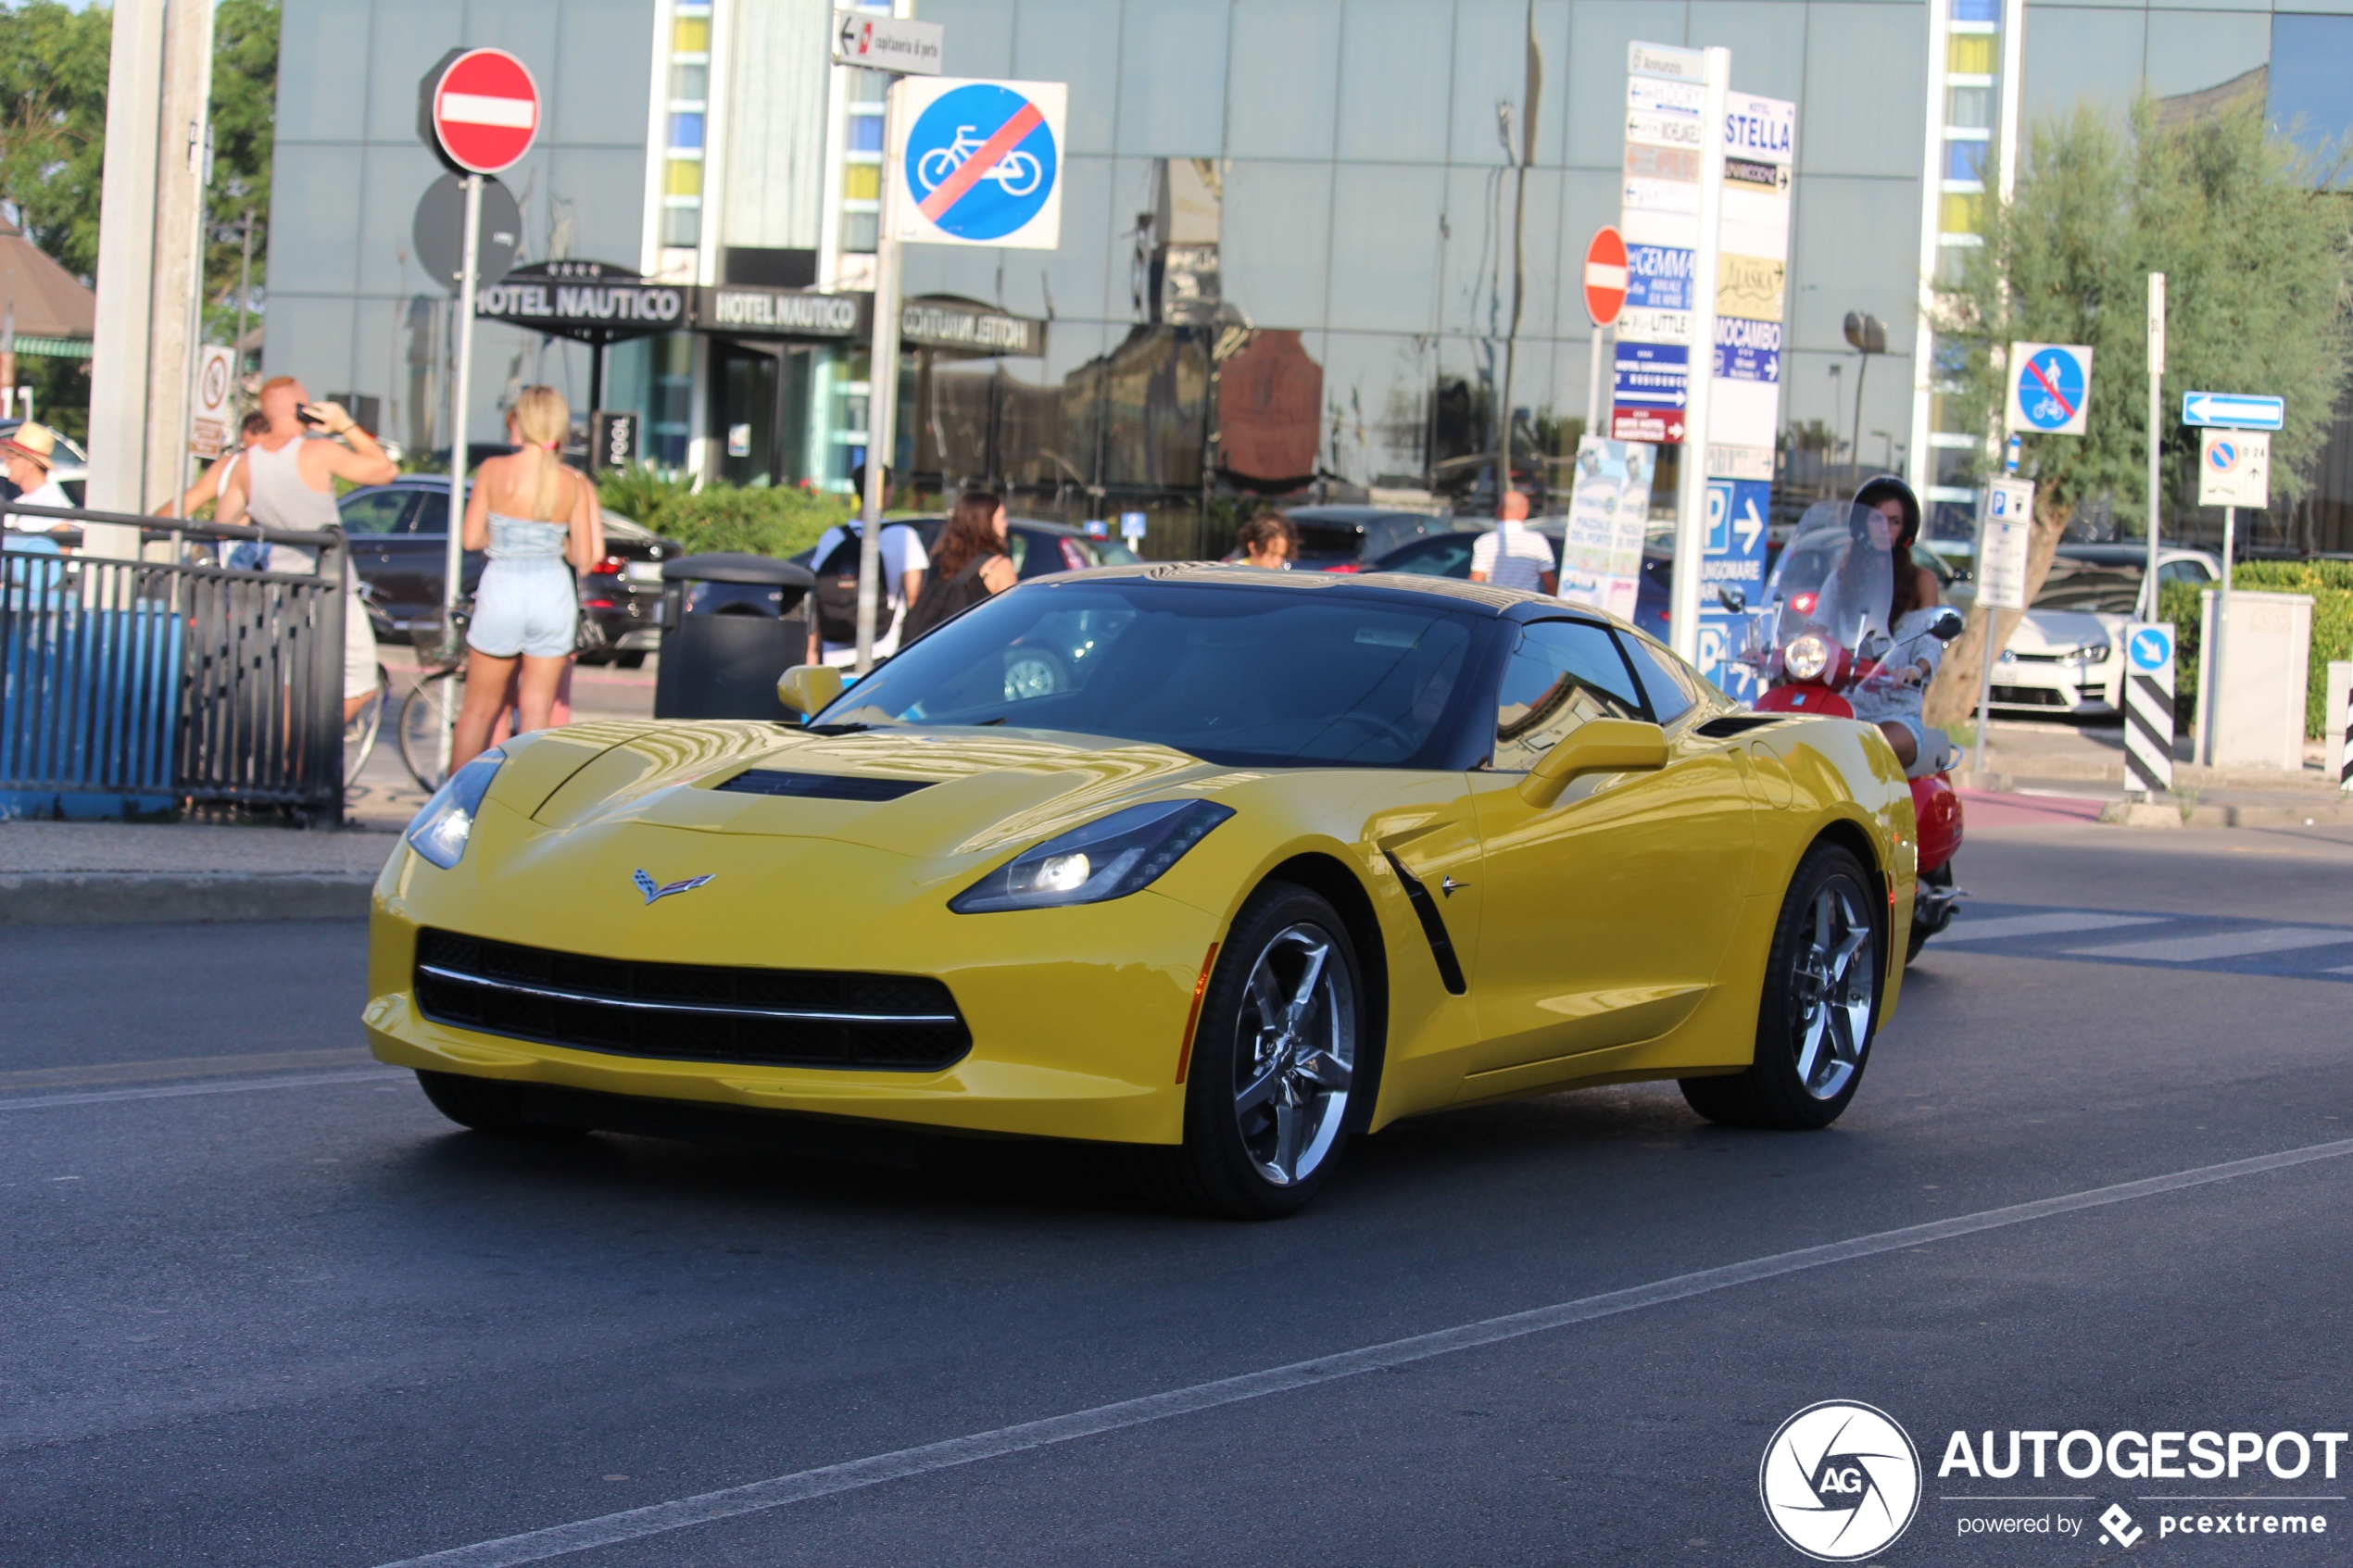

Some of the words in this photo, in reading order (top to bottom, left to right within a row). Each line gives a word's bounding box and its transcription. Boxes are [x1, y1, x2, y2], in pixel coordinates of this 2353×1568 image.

[1725, 113, 1790, 153] STELLA
[1637, 247, 1695, 279] GEMMA
[555, 284, 682, 321] NAUTICO
[715, 292, 774, 325] HOTEL
[776, 295, 857, 331] NAUTICO
[1652, 314, 1686, 333] LITTLE
[1714, 317, 1780, 352] MOCAMBO
[610, 416, 631, 465] POOL
[1701, 560, 1760, 582] UNGOMARE
